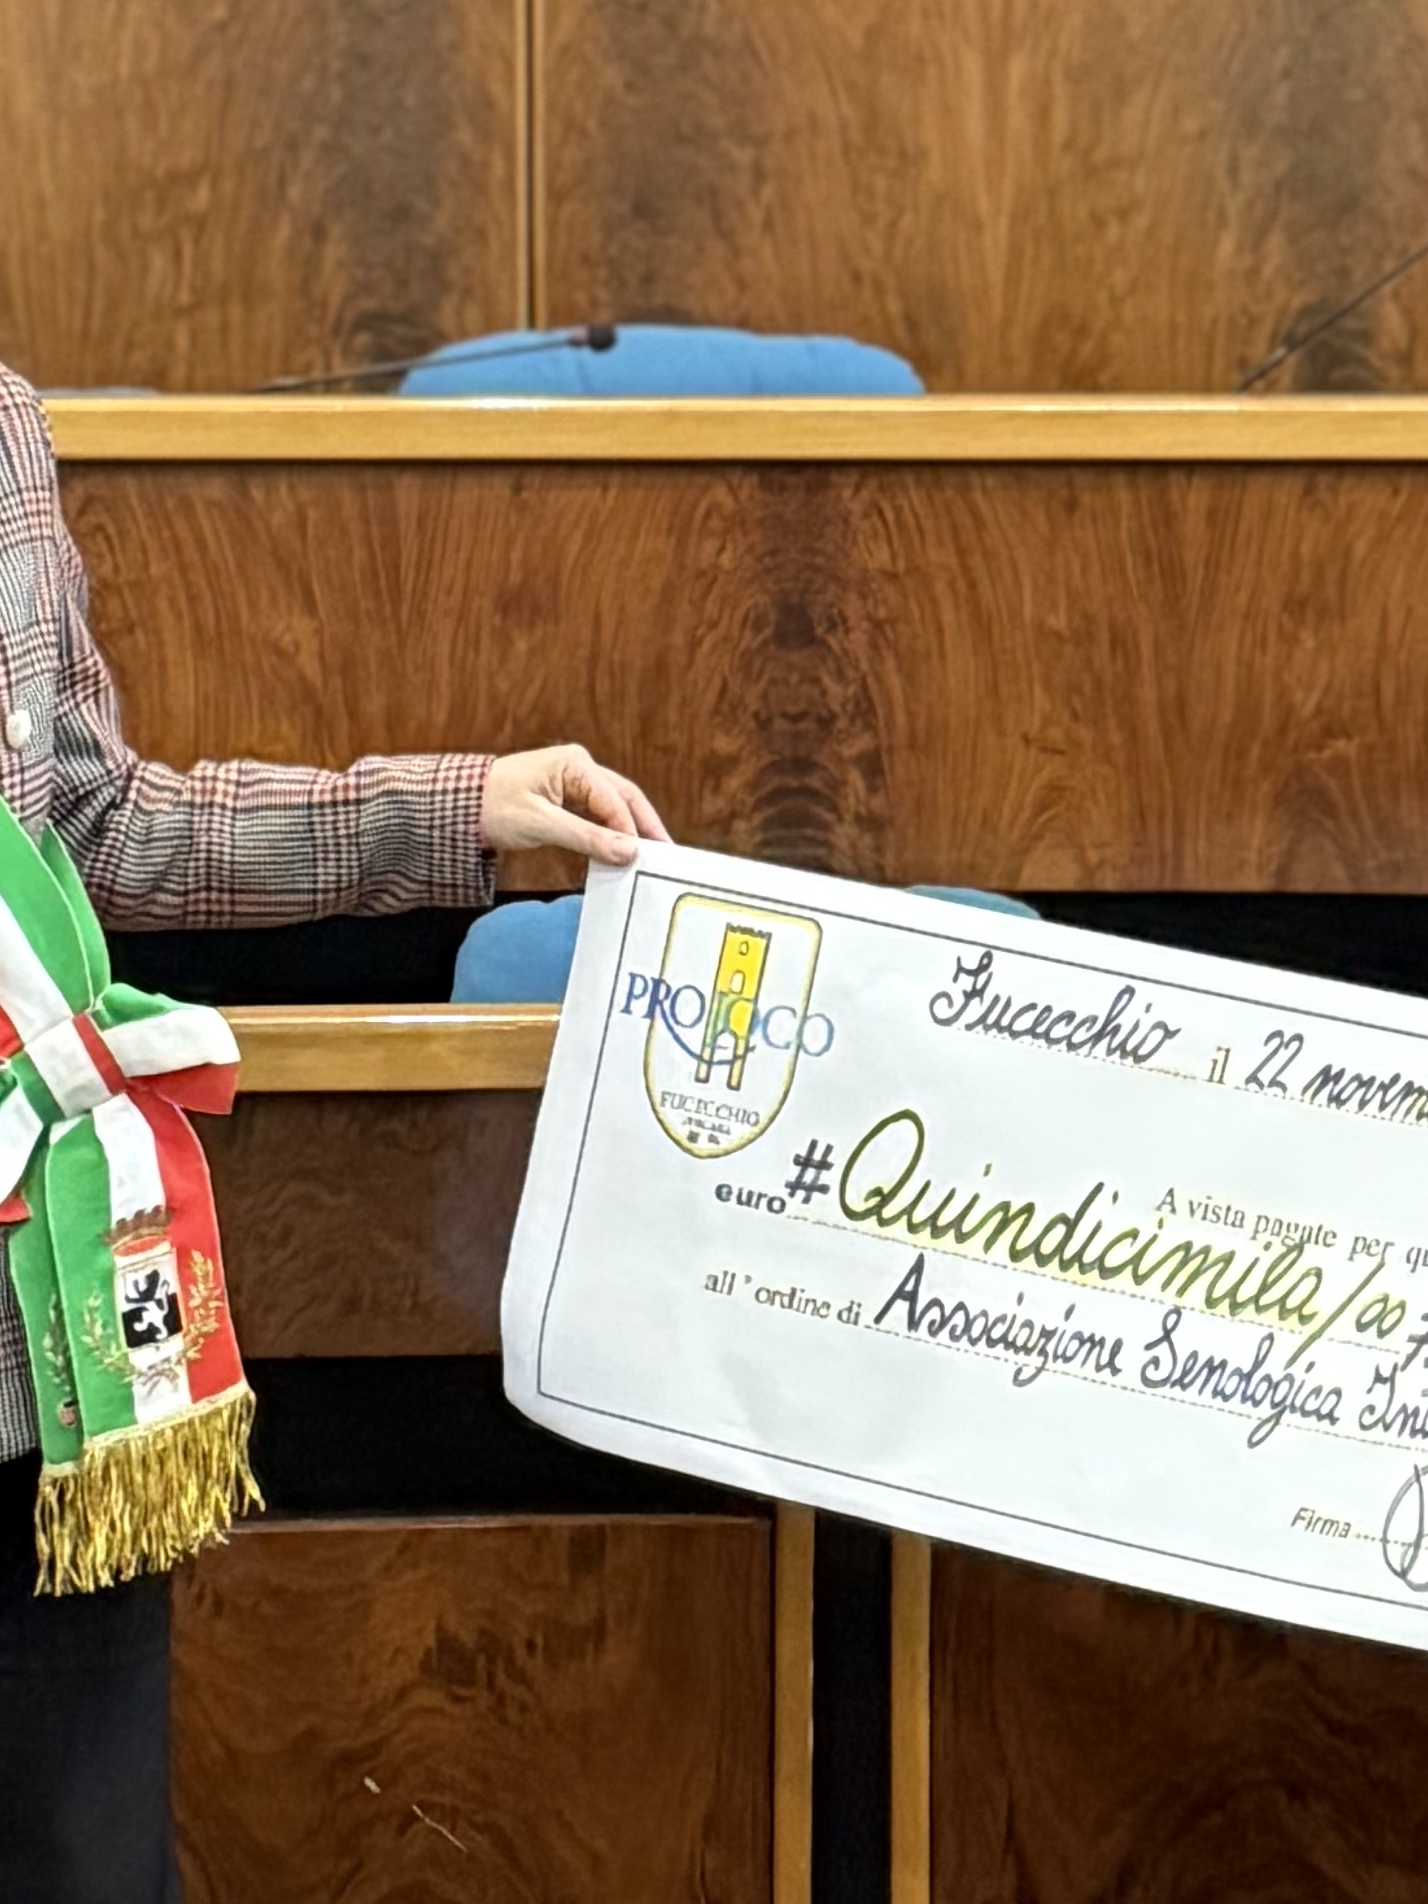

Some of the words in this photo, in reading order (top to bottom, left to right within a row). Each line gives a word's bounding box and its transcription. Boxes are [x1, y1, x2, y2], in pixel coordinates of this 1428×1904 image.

[619, 971, 707, 1030] PRO
[928, 949, 1183, 1065] Fucecchio
[1204, 1044, 1231, 1085] il
[1243, 1028, 1304, 1095] 22
[714, 1181, 787, 1215] euro
[1154, 1186, 1178, 1216] A
[1187, 1195, 1245, 1230] vista
[1251, 1212, 1338, 1249] pagate
[1346, 1234, 1396, 1262] per
[836, 1300, 863, 1326] di
[872, 1251, 1123, 1388] Associazione
[1139, 1304, 1343, 1450] Senologica
[1290, 1505, 1353, 1540] Firma
